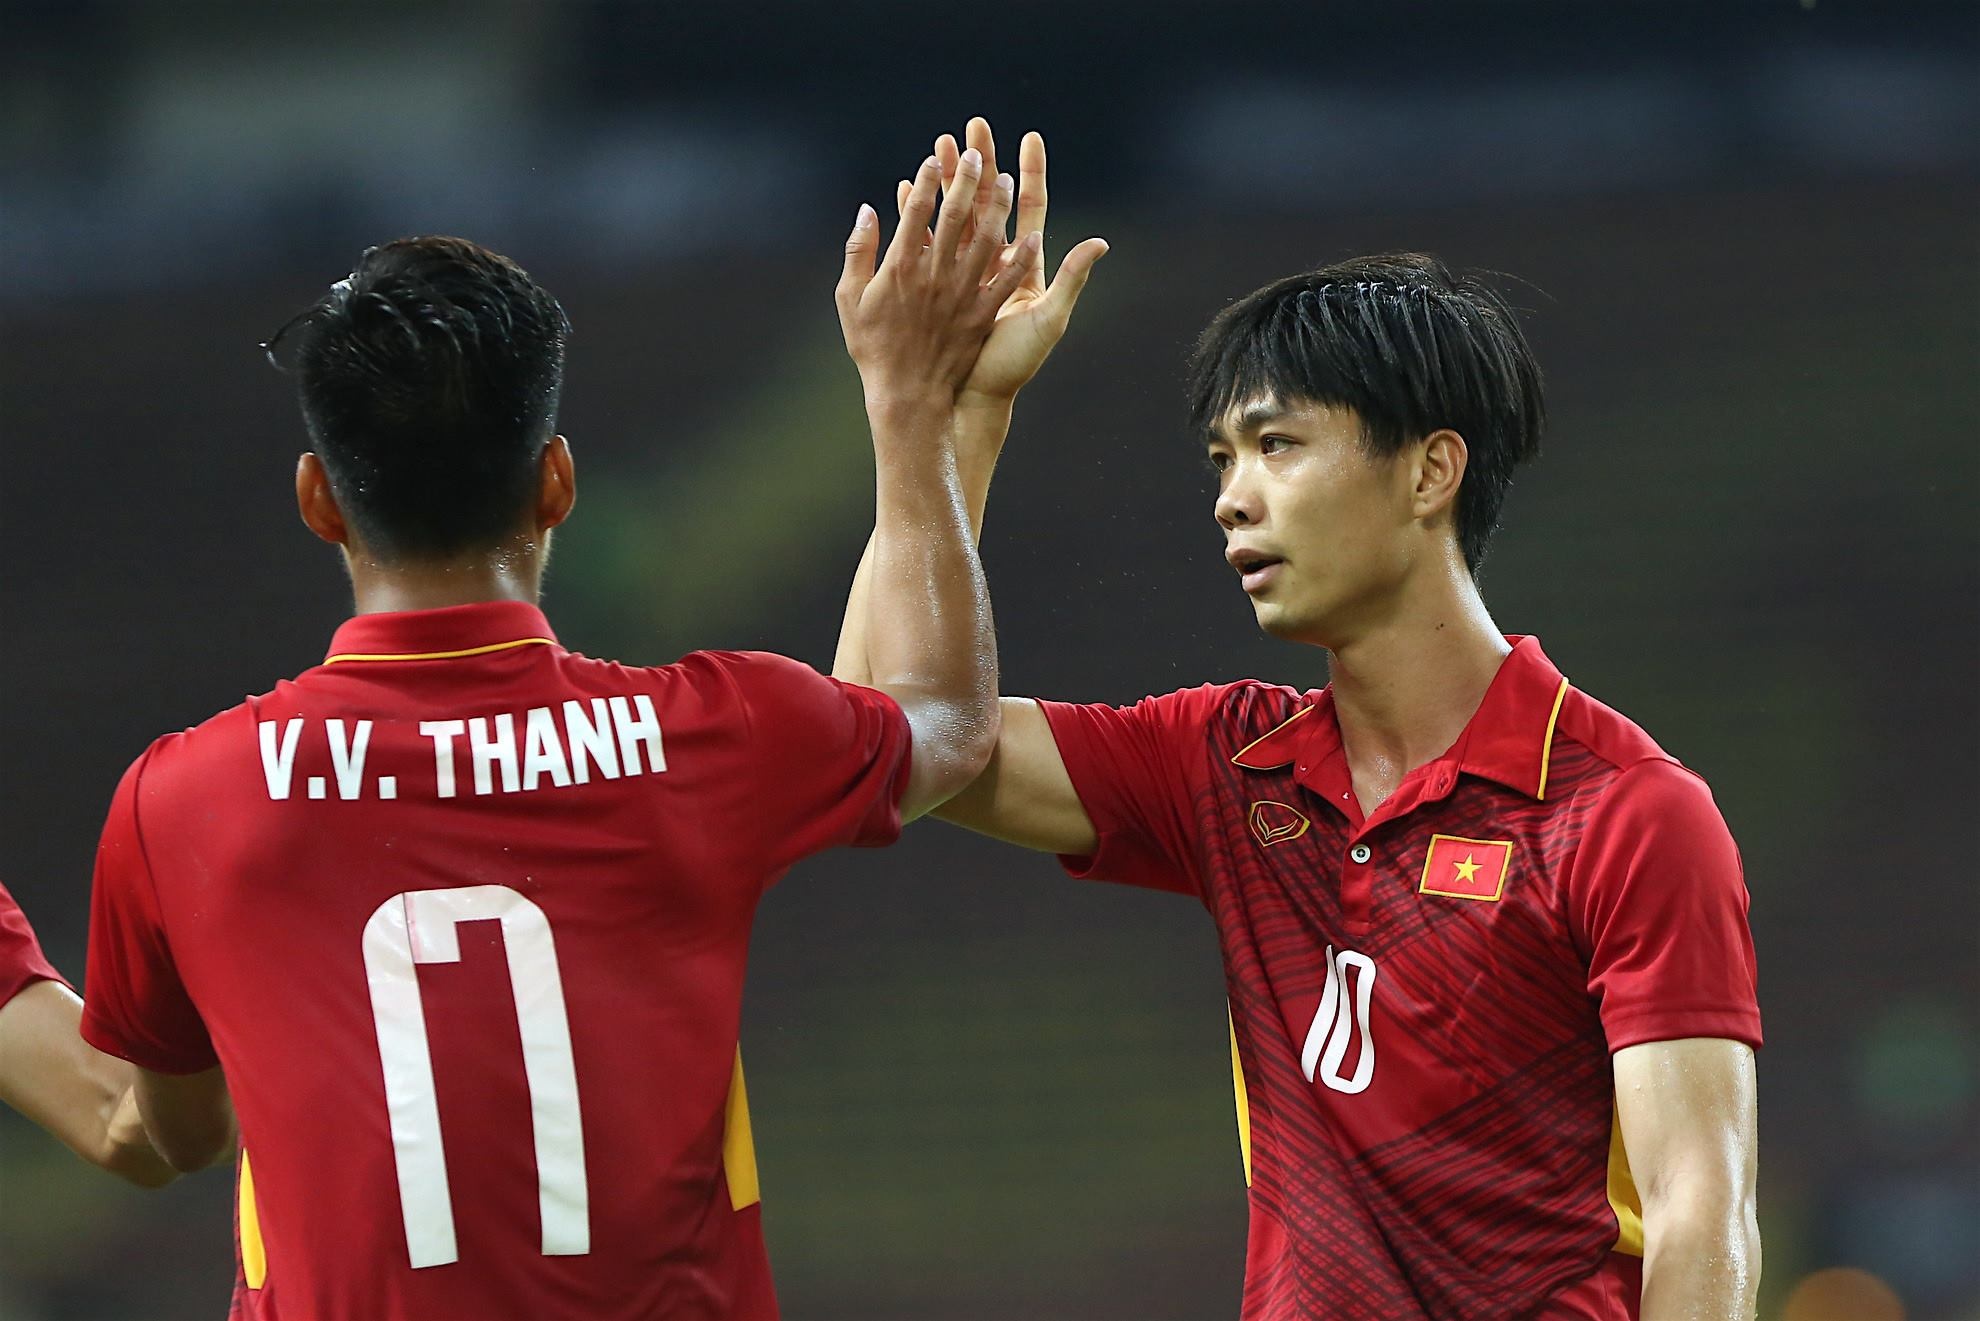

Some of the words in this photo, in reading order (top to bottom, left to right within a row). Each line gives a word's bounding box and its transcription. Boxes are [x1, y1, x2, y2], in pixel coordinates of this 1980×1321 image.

[258, 718, 397, 801] V.V.
[419, 694, 668, 799] THANH
[1301, 944, 1377, 1095] 10
